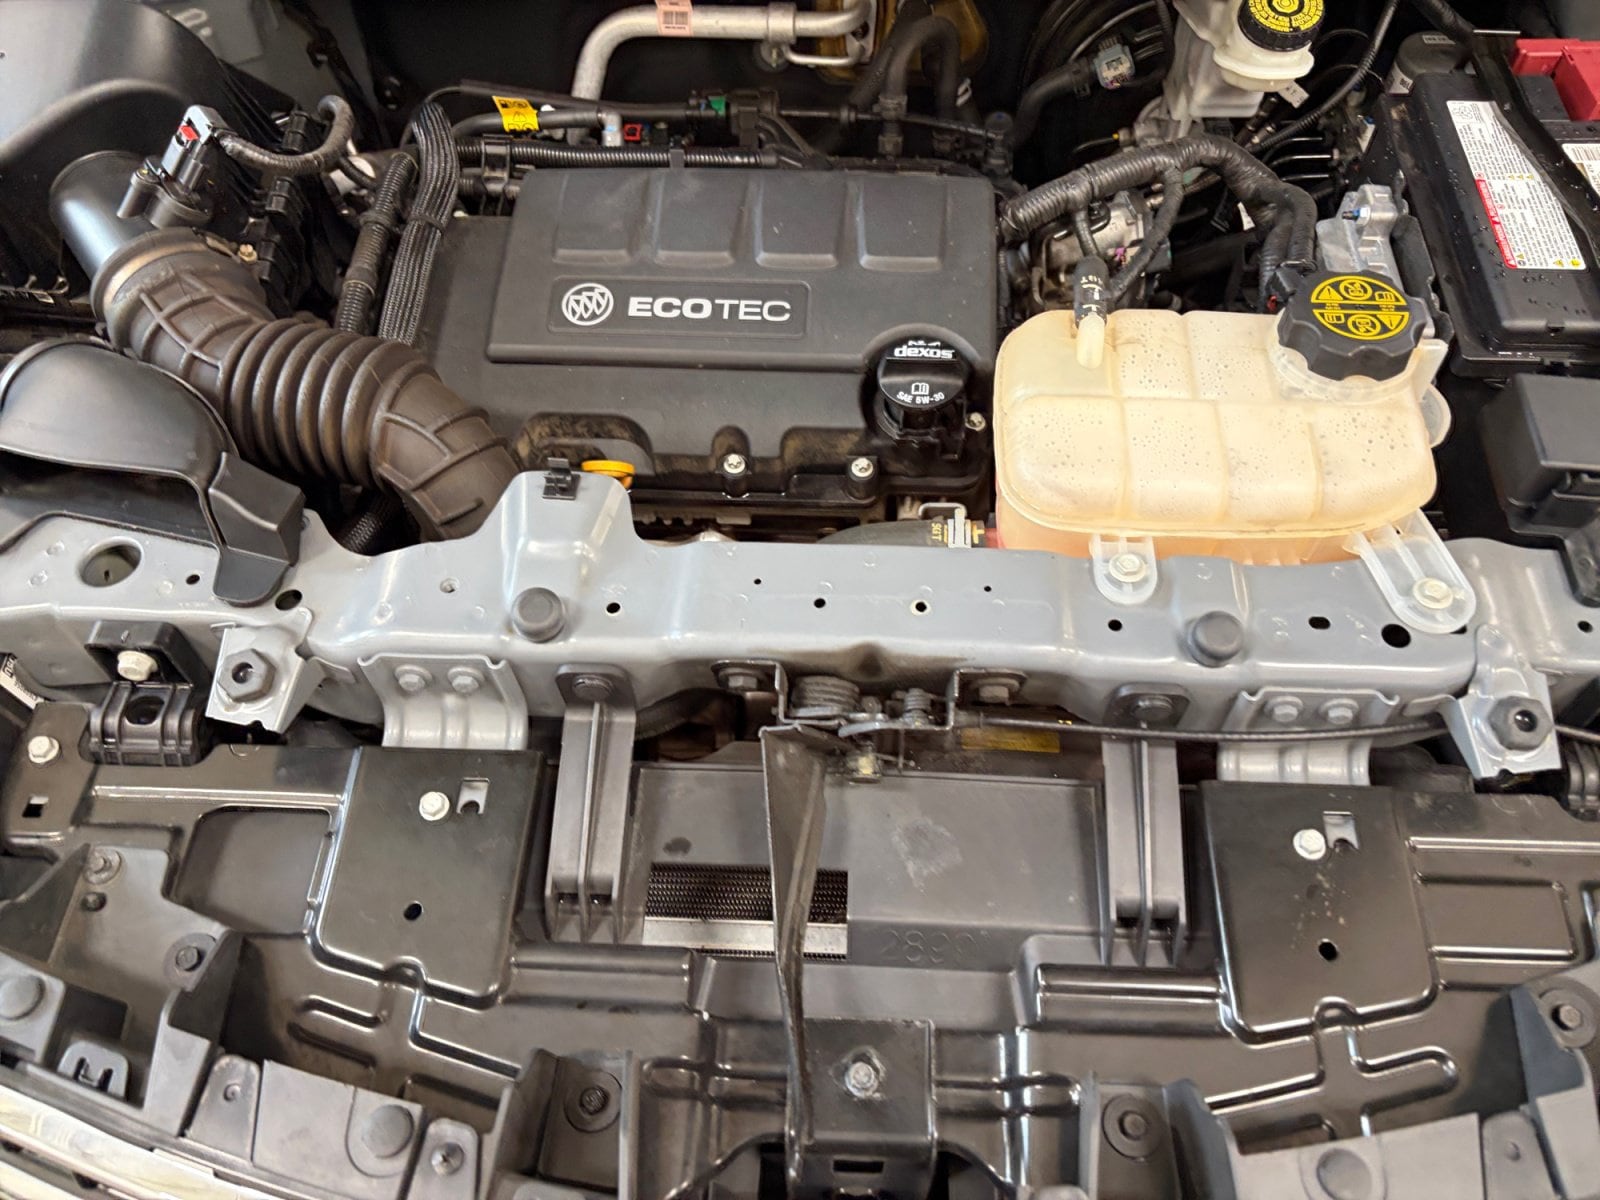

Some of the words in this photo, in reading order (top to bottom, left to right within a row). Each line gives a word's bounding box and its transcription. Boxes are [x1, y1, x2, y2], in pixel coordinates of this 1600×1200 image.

[627, 296, 791, 322] ECOTEC
[894, 346, 955, 359] dexos
[897, 391, 913, 403] SAE
[916, 391, 945, 404] 5W-30
